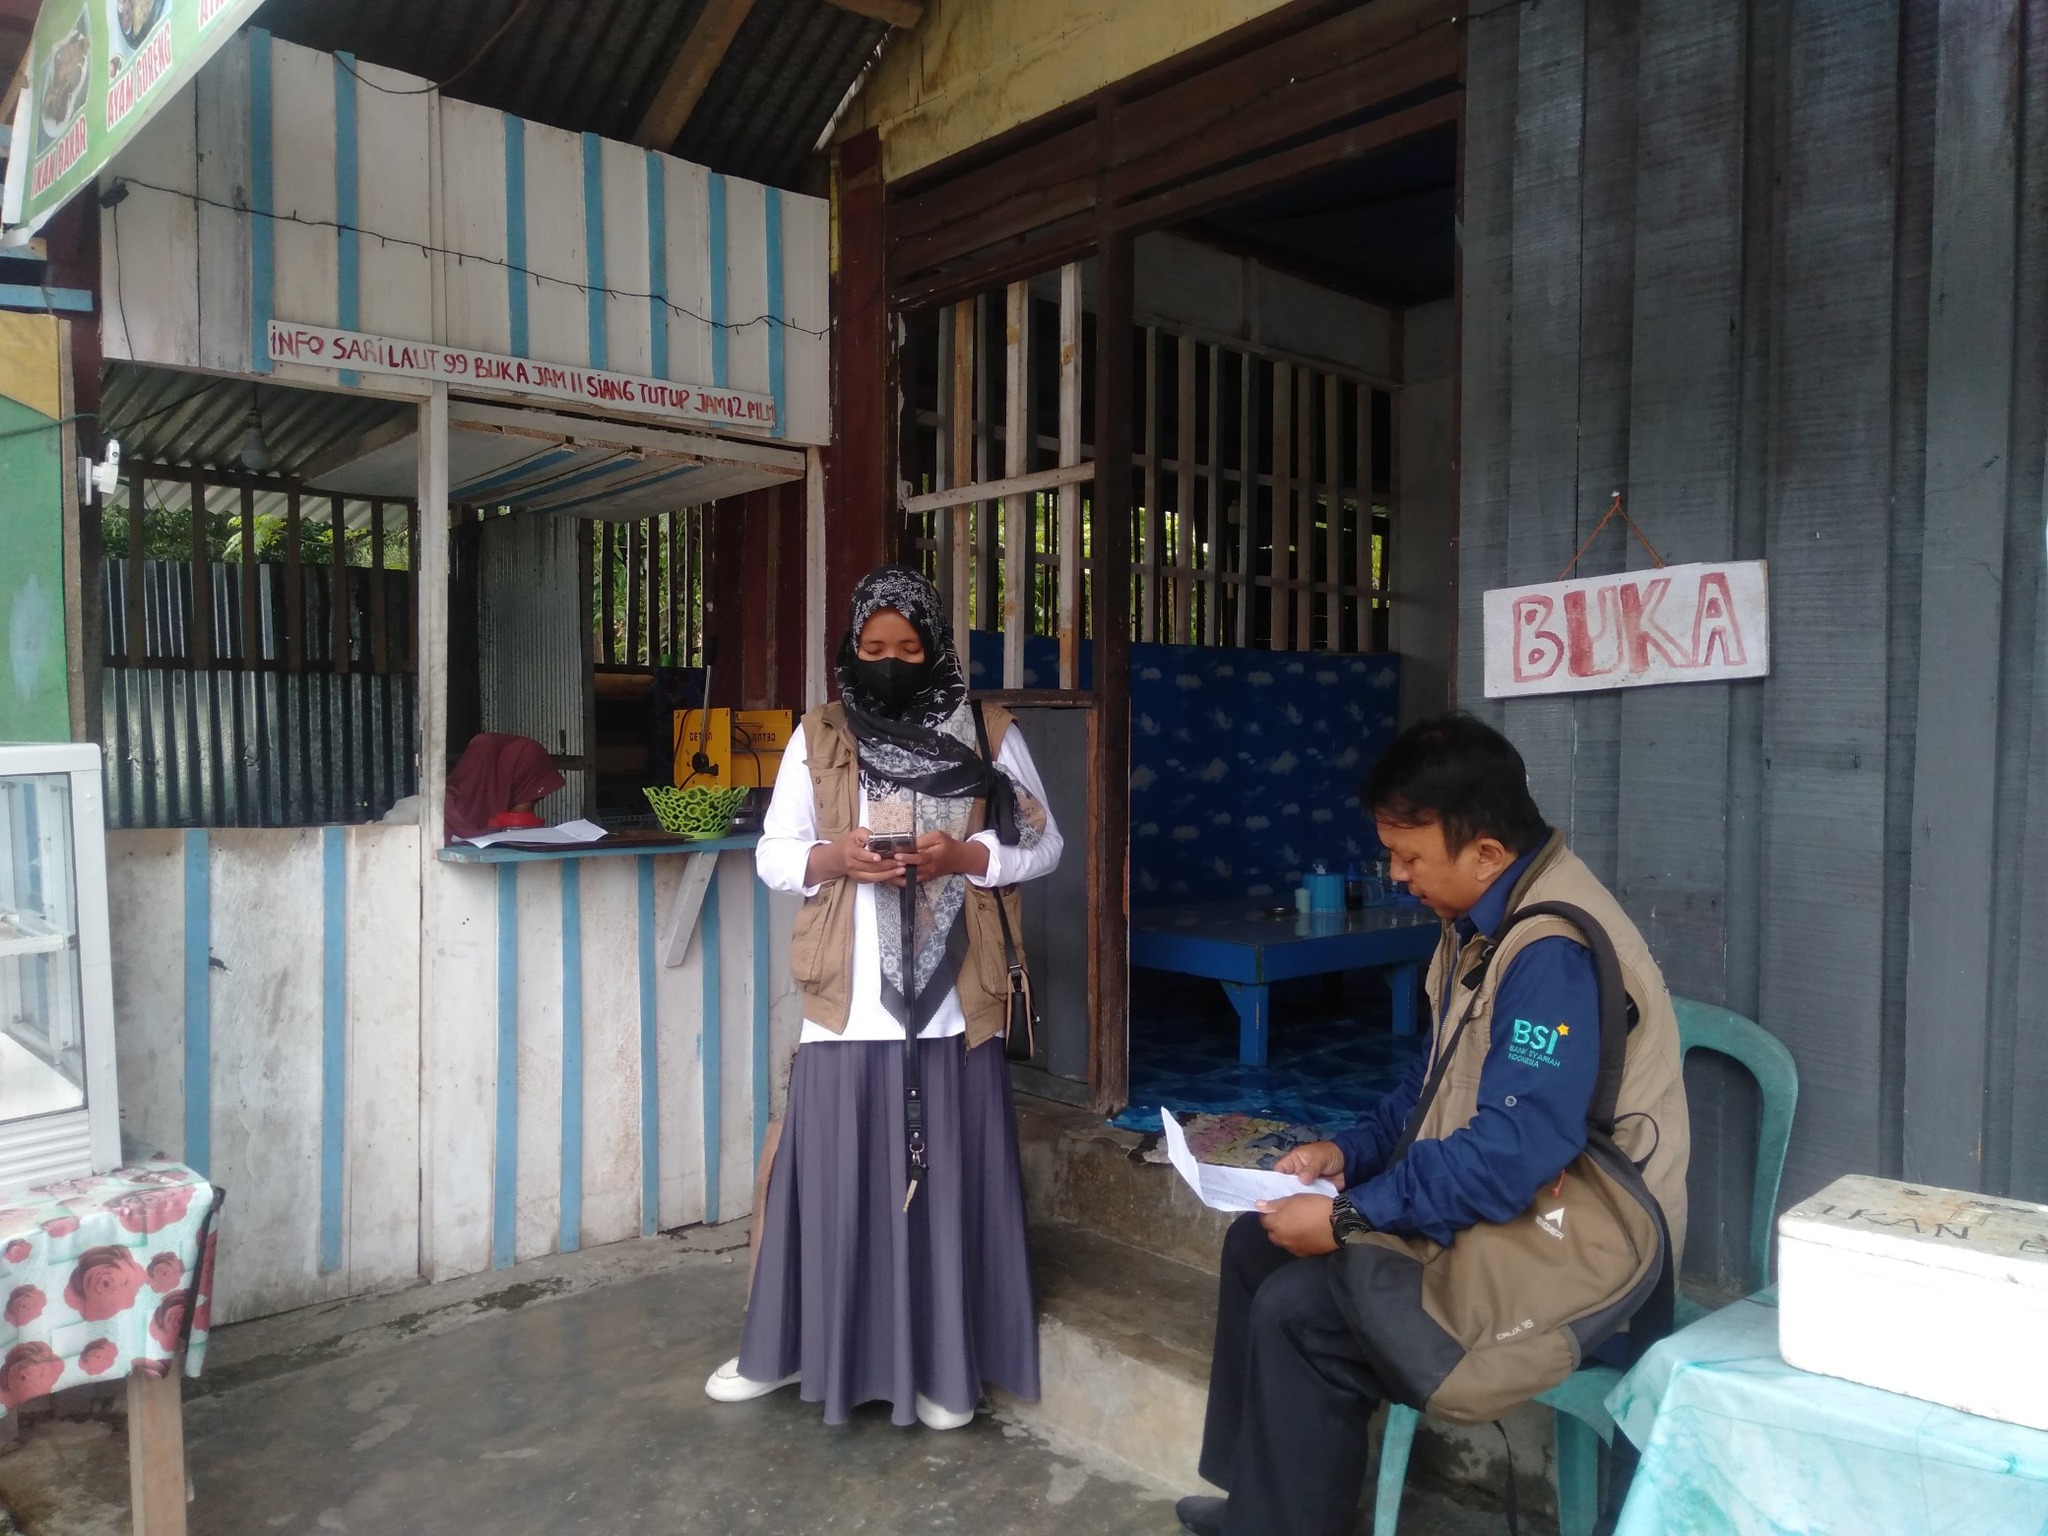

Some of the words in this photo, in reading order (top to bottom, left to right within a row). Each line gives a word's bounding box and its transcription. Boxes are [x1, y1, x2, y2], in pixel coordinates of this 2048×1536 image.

[106, 67, 134, 131] AYAM
[136, 20, 172, 102] GORENG
[32, 147, 56, 199] IKAN
[57, 115, 87, 179] BAKAR
[388, 345, 439, 372] LAUT
[443, 353, 468, 375] 99
[474, 357, 530, 384] BUKA
[532, 365, 567, 391] JAM
[638, 383, 690, 410] TUTUP
[694, 387, 727, 415] JAM
[1511, 572, 1748, 683] BUKA
[1512, 1018, 1559, 1055] BSI
[1507, 1052, 1540, 1069] INDONESIA
[1509, 1044, 1528, 1055] BANK
[1528, 1050, 1561, 1068] SYARIAH
[1535, 1215, 1565, 1241] EIGER
[1822, 1205, 1970, 1240] IKAN
